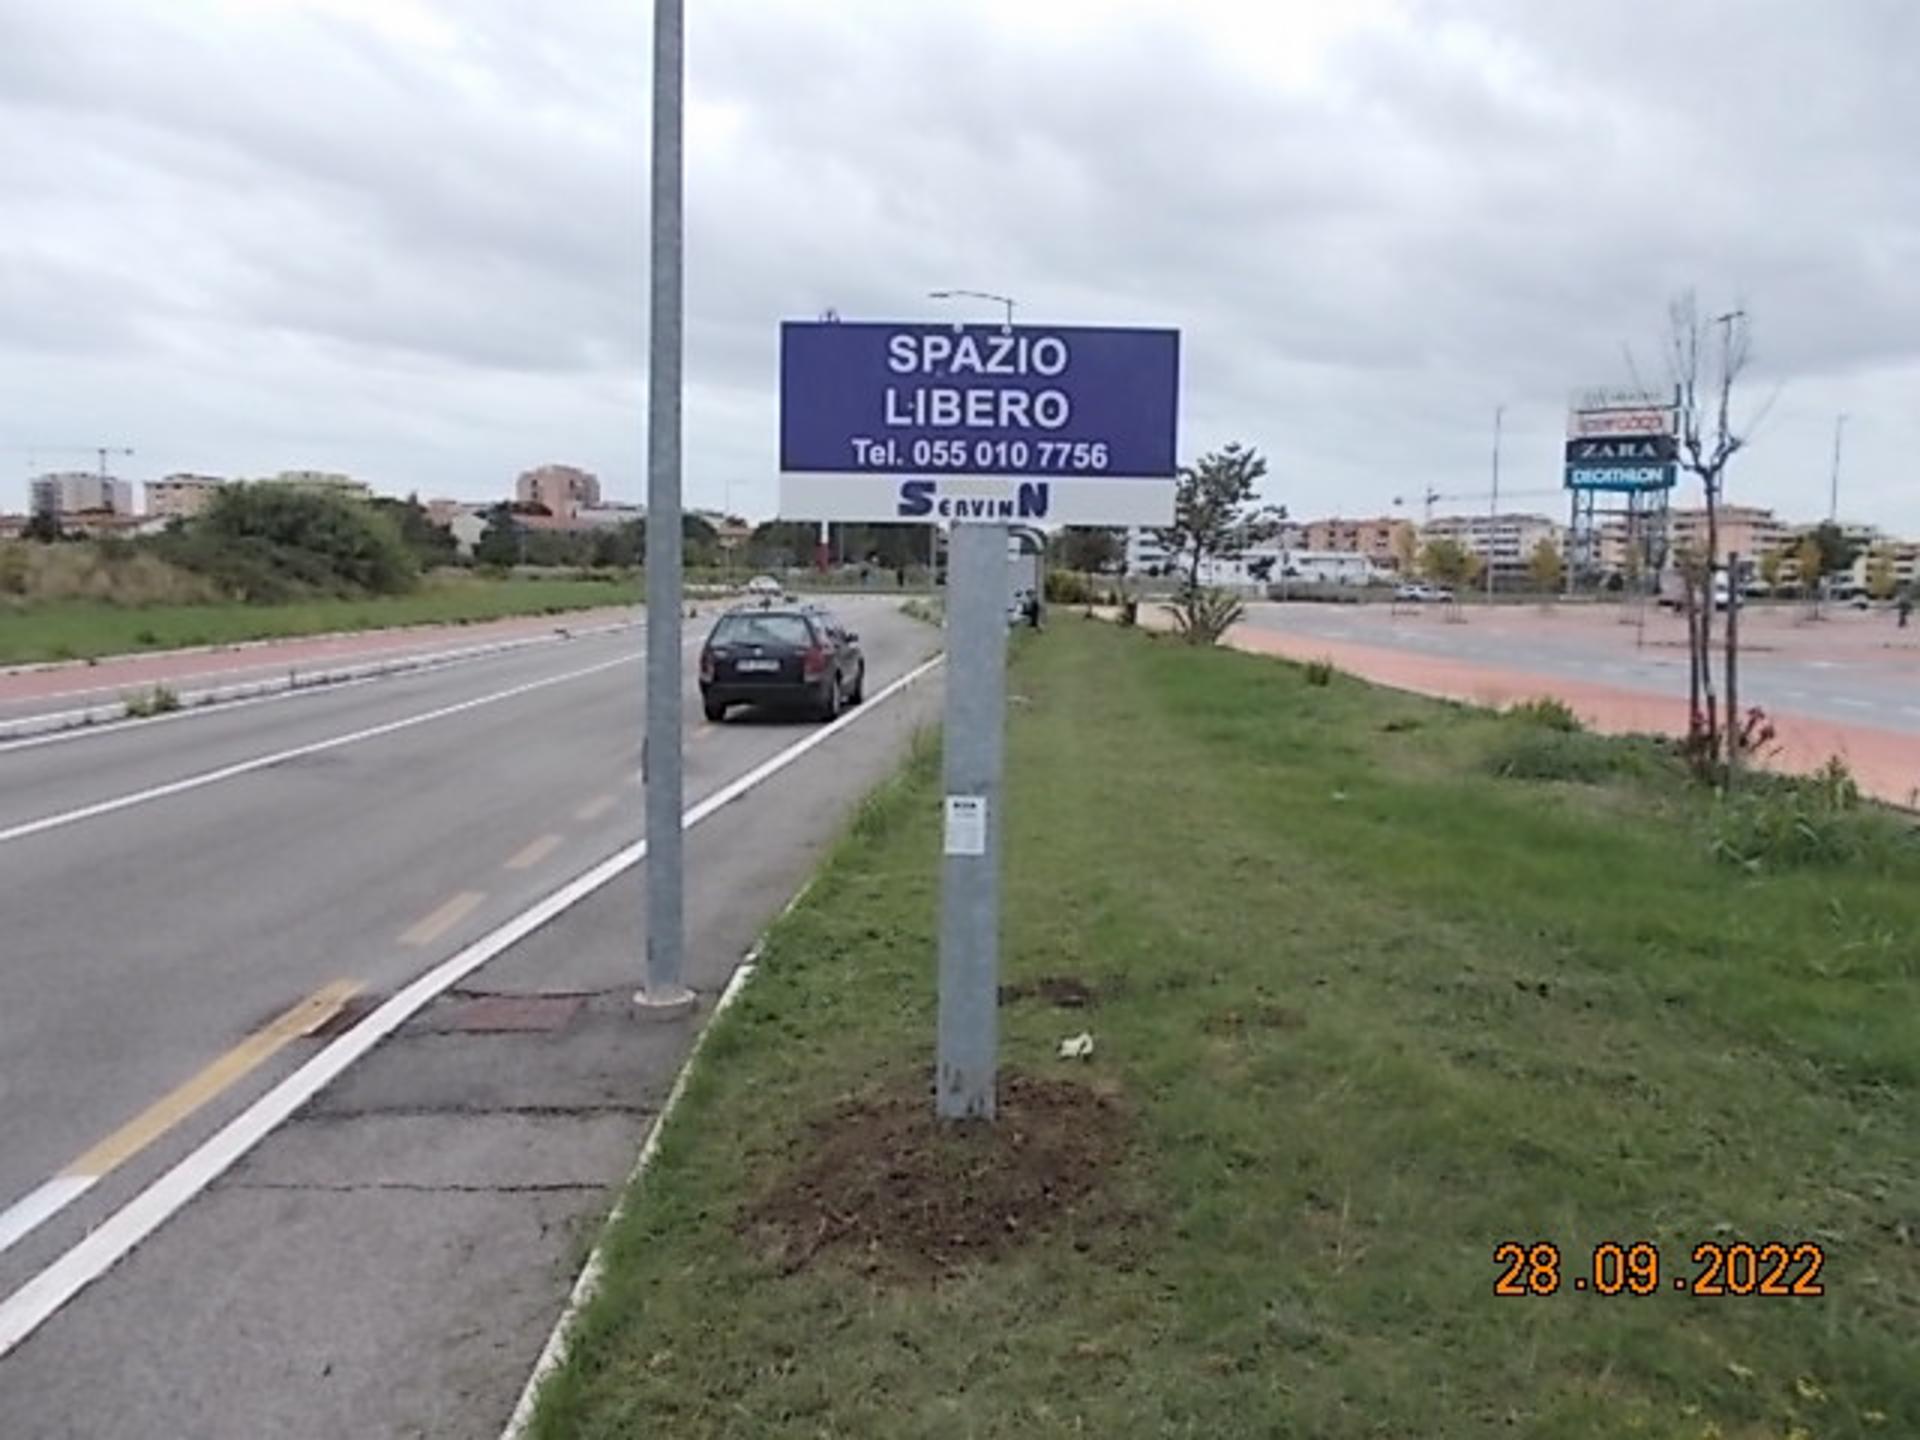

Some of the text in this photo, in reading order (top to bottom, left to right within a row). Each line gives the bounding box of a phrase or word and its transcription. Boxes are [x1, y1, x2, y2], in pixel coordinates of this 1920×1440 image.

[888, 334, 1068, 375] SPAZIO
[885, 387, 1070, 428] LIBERO
[852, 438, 1109, 469] Tel. 055 010 7756
[1581, 442, 1658, 458] ZARA
